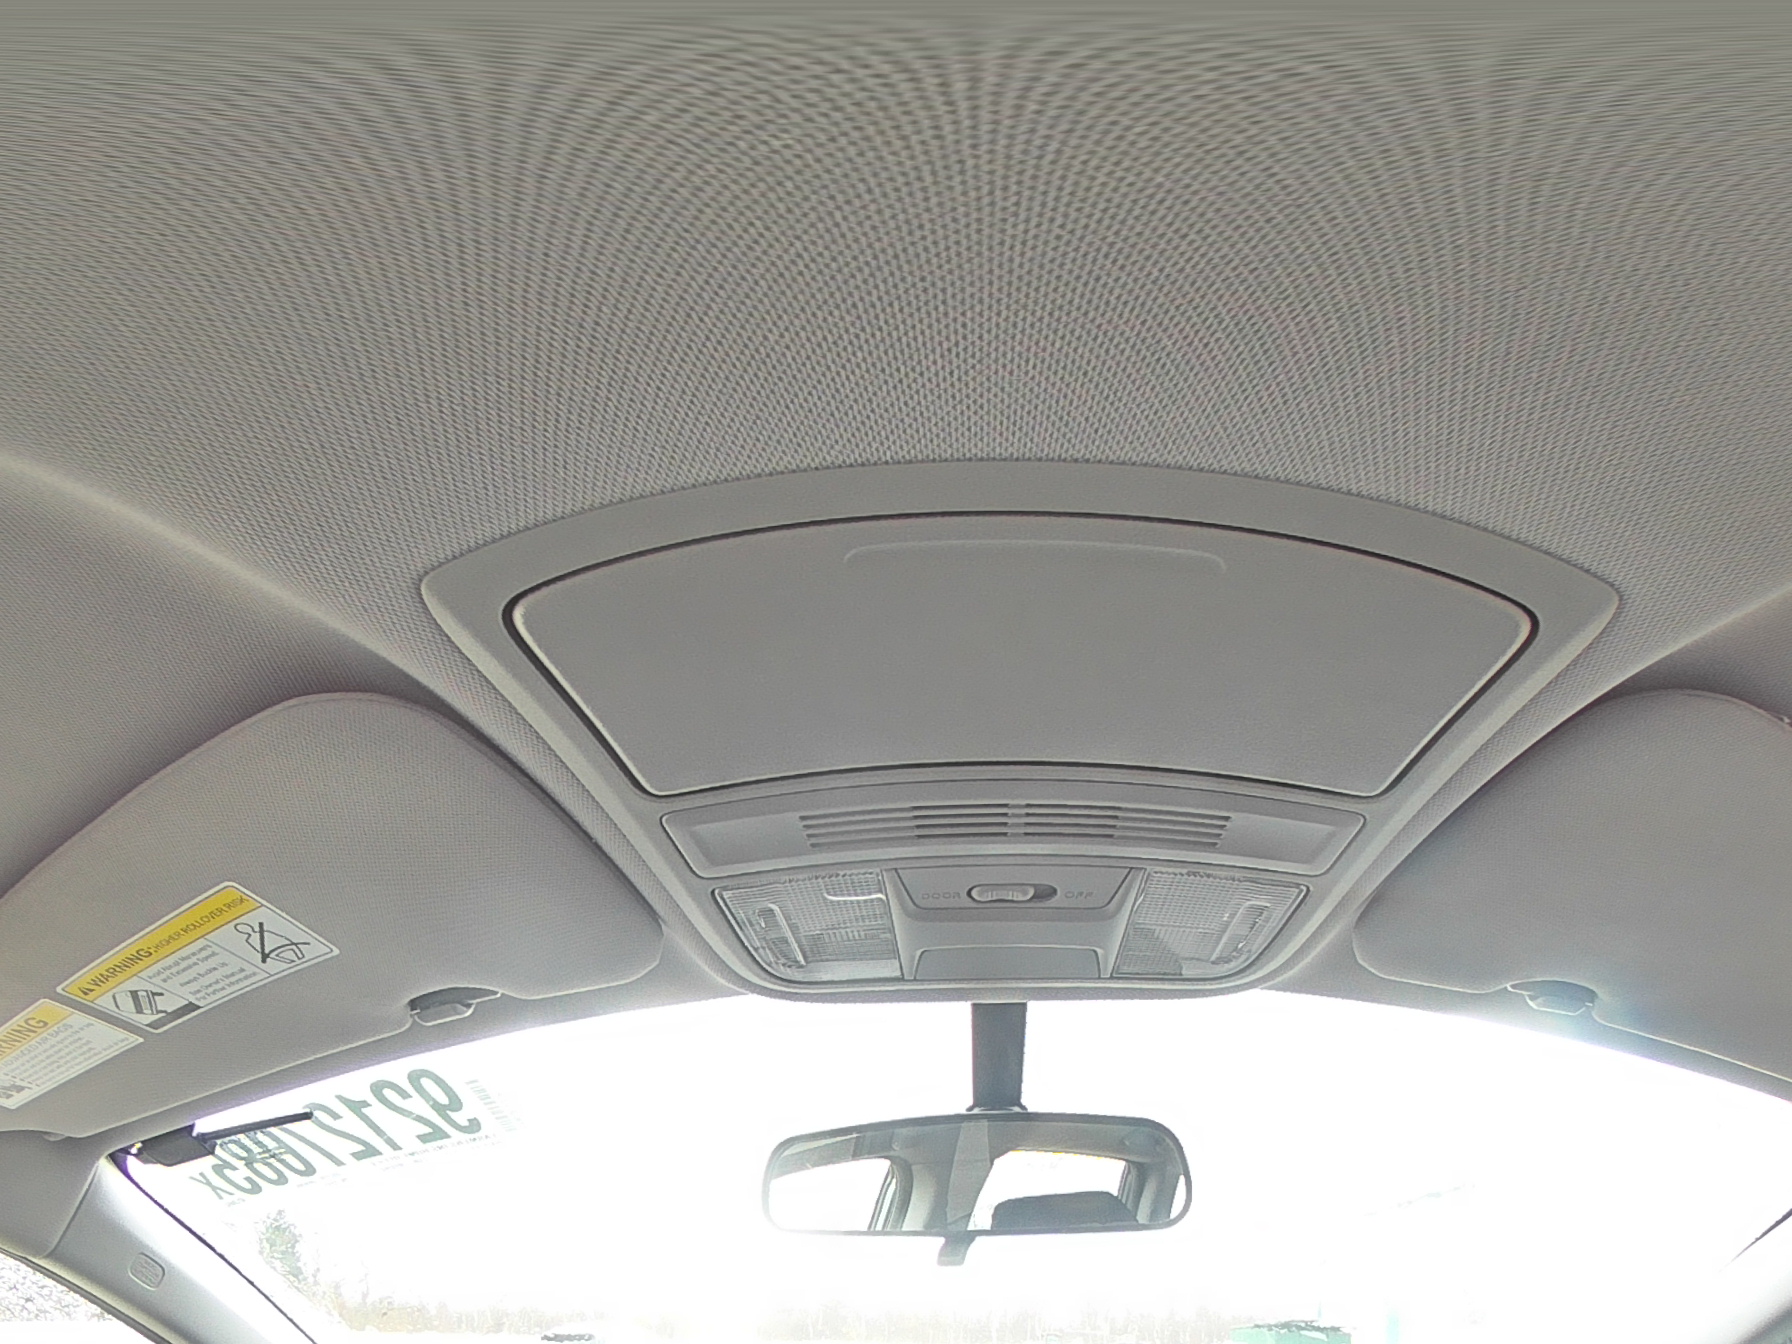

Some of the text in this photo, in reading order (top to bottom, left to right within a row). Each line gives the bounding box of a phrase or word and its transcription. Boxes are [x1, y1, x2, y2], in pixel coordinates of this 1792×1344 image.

[921, 891, 961, 901] DOOR
[1064, 890, 1094, 900] OFF
[92, 945, 158, 989] WARNING:
